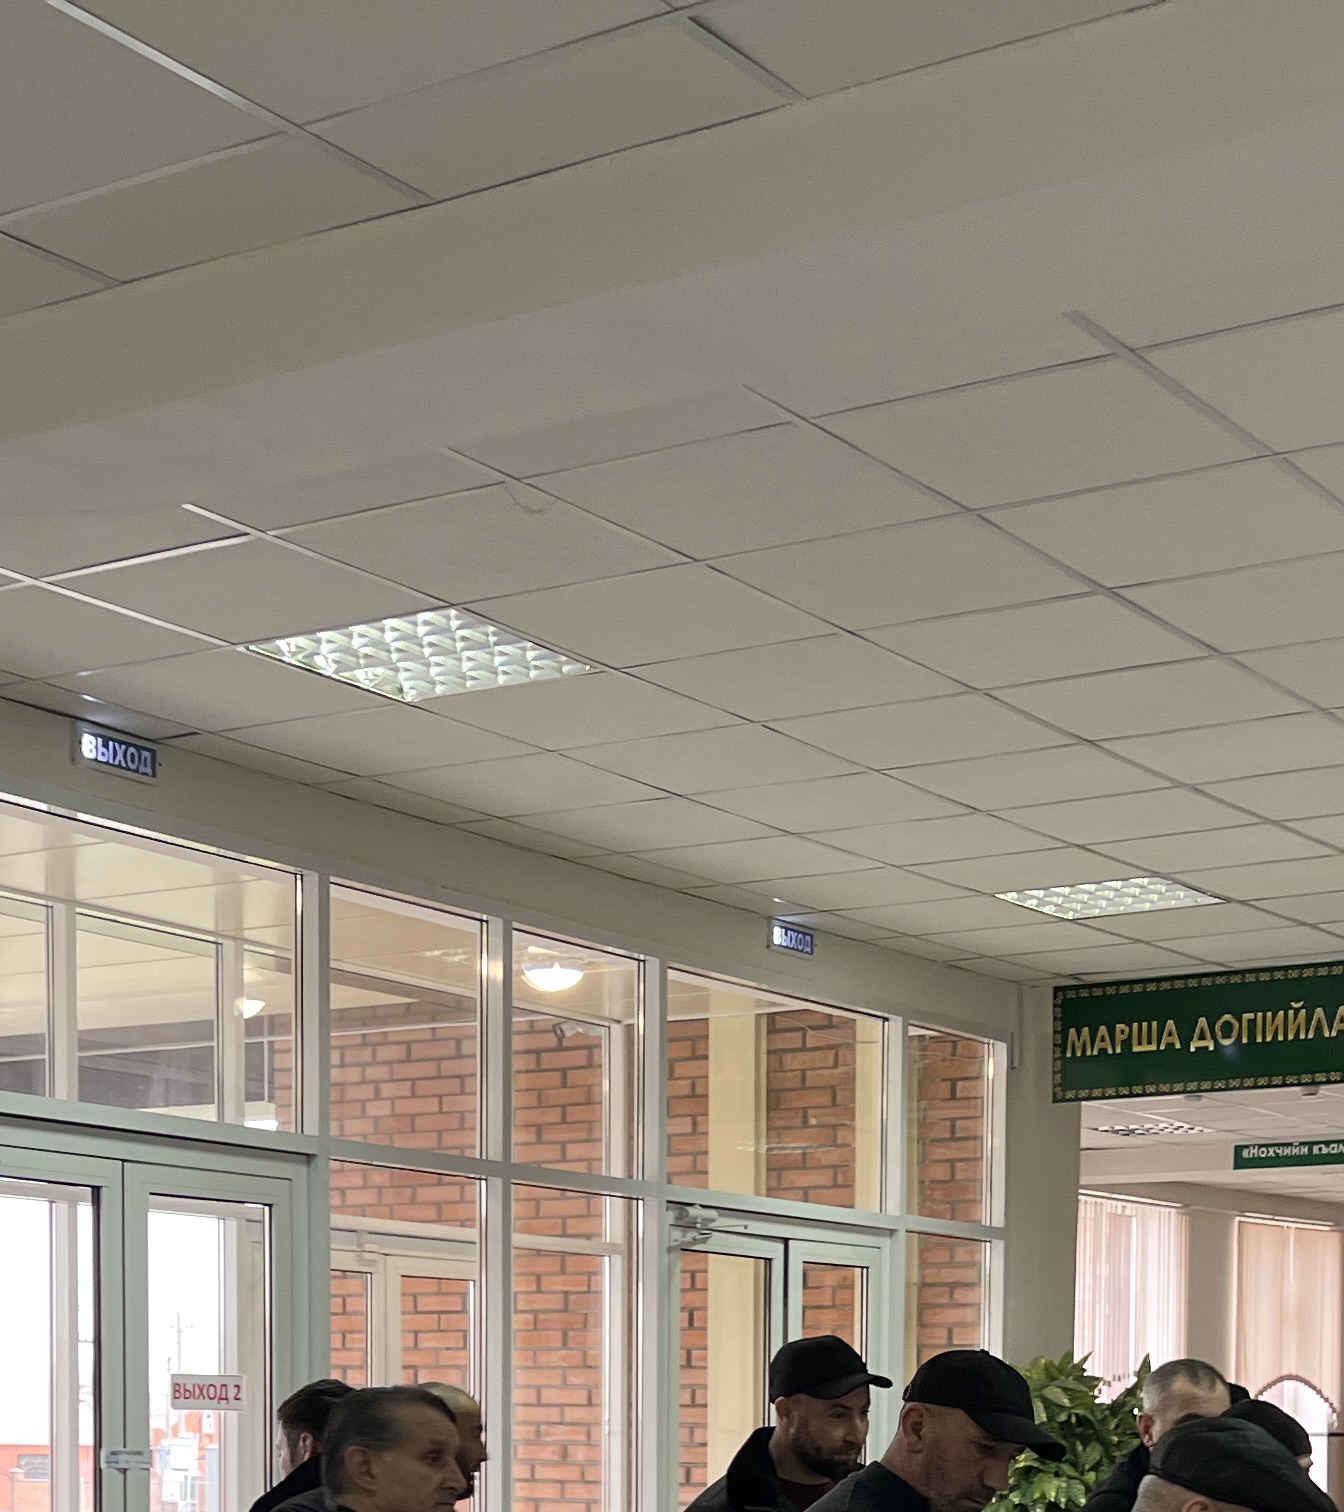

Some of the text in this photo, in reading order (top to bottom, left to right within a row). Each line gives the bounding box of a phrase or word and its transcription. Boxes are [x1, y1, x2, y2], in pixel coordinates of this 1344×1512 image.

[81, 732, 153, 778] ВЫХОД
[773, 926, 812, 953] ВЫХОД
[1065, 1018, 1182, 1058] МАРША
[173, 1382, 242, 1404] ВЫХОД 2
